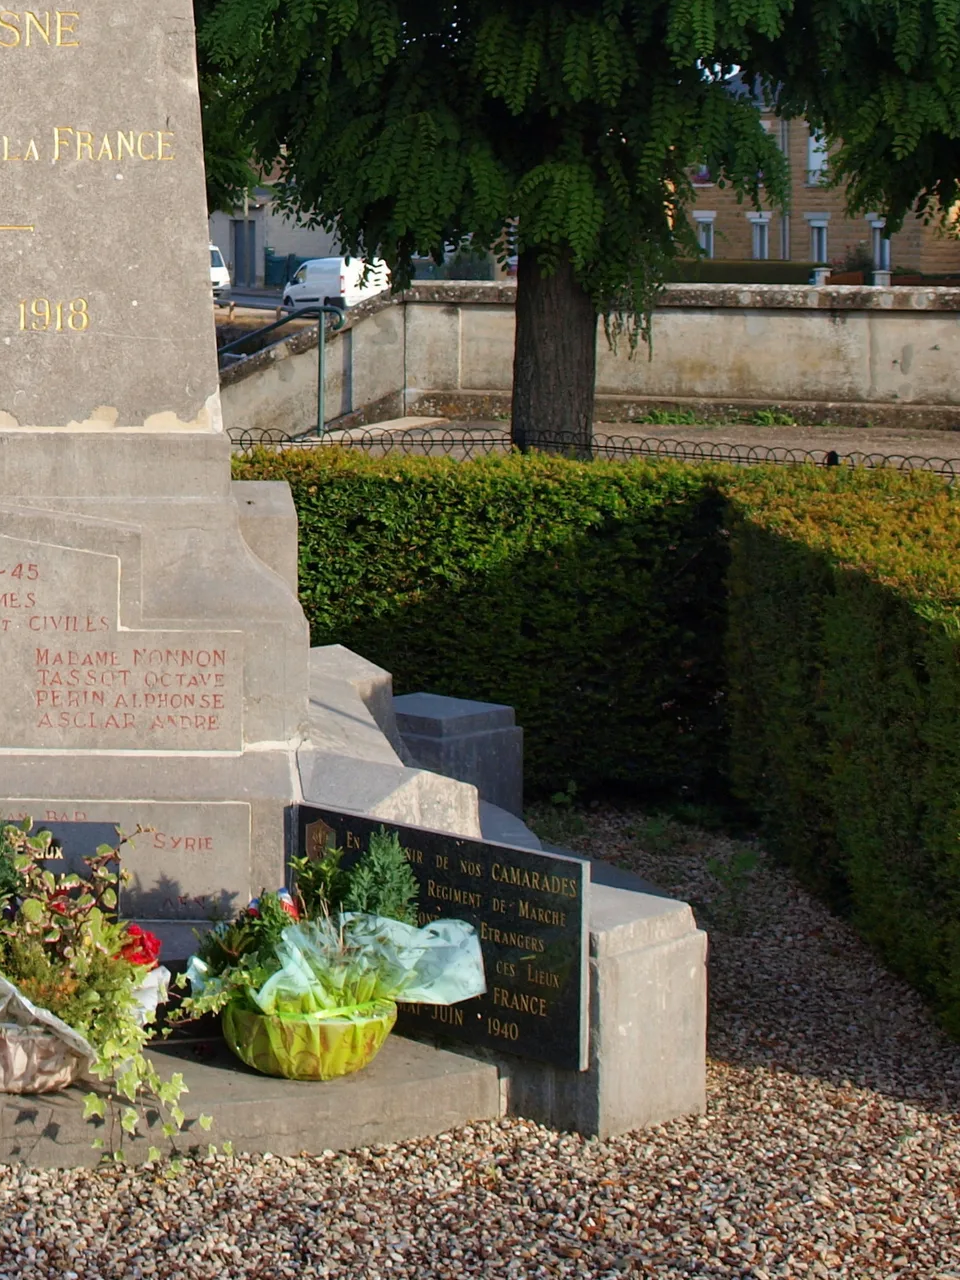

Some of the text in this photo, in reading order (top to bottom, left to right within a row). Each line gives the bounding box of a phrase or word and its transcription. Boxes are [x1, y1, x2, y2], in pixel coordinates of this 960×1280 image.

[52, 126, 175, 161] FRANCE
[19, 298, 90, 331] 1918
[29, 615, 110, 633] CIVILES
[36, 648, 122, 666] MADAME
[144, 672, 226, 688] OCTAVE
[114, 693, 226, 709] ALPHONSE
[153, 832, 214, 852] SYRIE
[346, 831, 361, 849] EN
[436, 854, 449, 870] DE
[460, 860, 482, 877] NOS
[491, 863, 577, 898] CAMARADES
[519, 900, 567, 928] MARCHE
[496, 960, 561, 989] CES LIEUX
[493, 986, 547, 1018] FRANCE
[487, 1016, 520, 1042] 1940
